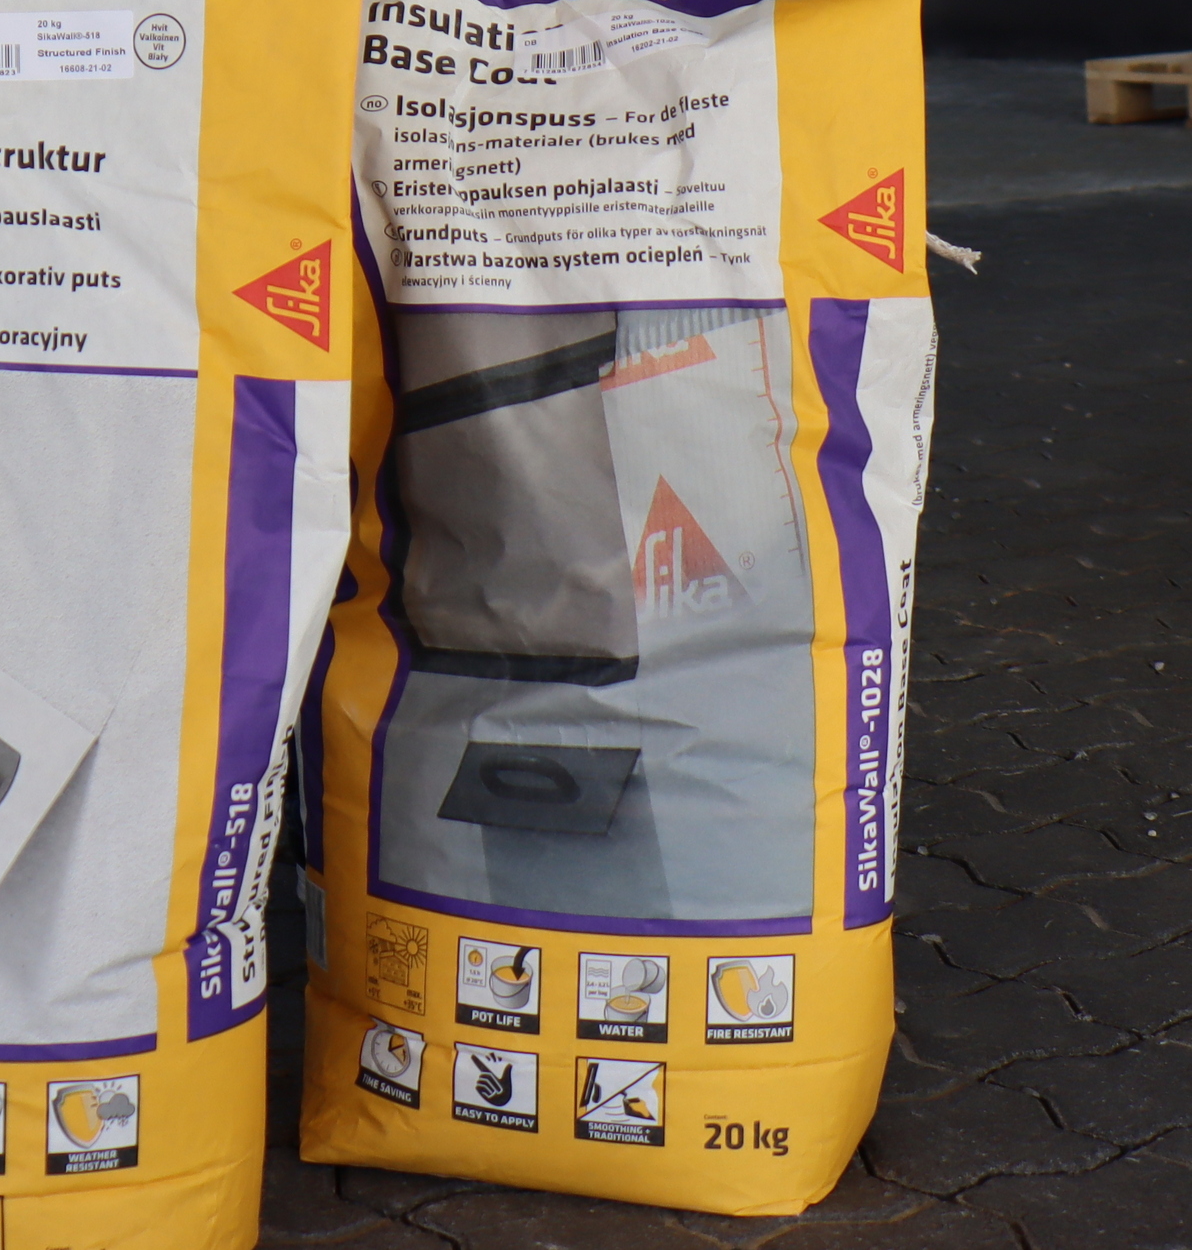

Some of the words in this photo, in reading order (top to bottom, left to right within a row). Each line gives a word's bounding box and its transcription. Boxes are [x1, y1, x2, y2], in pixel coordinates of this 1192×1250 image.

[37, 20, 48, 28] 20
[51, 20, 62, 30] kg
[368, 0, 515, 51] Insulati
[624, 13, 634, 21] kg
[151, 24, 168, 32] Hvit
[139, 33, 179, 42] Valkoinen
[524, 39, 537, 47] DB
[37, 49, 92, 58] Structured
[95, 48, 126, 57] Finish
[153, 43, 164, 51] Vit
[363, 34, 456, 75] Base
[60, 64, 112, 73] 16608-21-02
[396, 95, 596, 132] Isolasjonspuss
[625, 111, 656, 123] For
[660, 105, 677, 122] de
[678, 94, 729, 112] fleste
[394, 128, 582, 153] isolasns-materialer
[589, 132, 659, 148] (brukes
[666, 123, 695, 145] med
[393, 157, 521, 181] armerigsnett)
[393, 180, 547, 206] Eristeppauksen
[553, 178, 658, 200] pohjalaasti
[498, 202, 600, 219] monentyyppisille
[603, 200, 715, 215] eristemateriaaleille
[847, 186, 896, 259] Sika
[397, 224, 488, 244] Grundputs
[505, 231, 563, 245] Grundputs
[566, 229, 583, 240] för
[587, 227, 616, 239] olika
[620, 227, 652, 240] typer
[656, 228, 668, 236] av
[483, 252, 549, 269] bazowa
[553, 250, 620, 271] system
[626, 245, 703, 266] ociepleń
[720, 252, 751, 265] Tynk
[71, 268, 122, 292] puts
[469, 275, 512, 289] ścienny
[266, 258, 320, 337] Sika
[472, 1010, 493, 1023] POT
[496, 1014, 521, 1027] LIFE
[599, 1024, 644, 1037] WATER
[707, 1028, 731, 1039] FIRE
[734, 1026, 792, 1039] RESISTANT
[362, 1073, 379, 1089] TIME
[380, 1082, 412, 1102] SAVING
[455, 1106, 482, 1119] EASY
[484, 1112, 498, 1122] TO
[500, 1115, 535, 1128] APPLY
[588, 1122, 643, 1134] SMOOTHING
[588, 1130, 650, 1143] TRADITIONAL
[704, 1123, 744, 1150] 20
[753, 1120, 790, 1156] kg
[68, 1150, 117, 1163] WEATHER
[66, 1159, 119, 1172] RESISTANT
